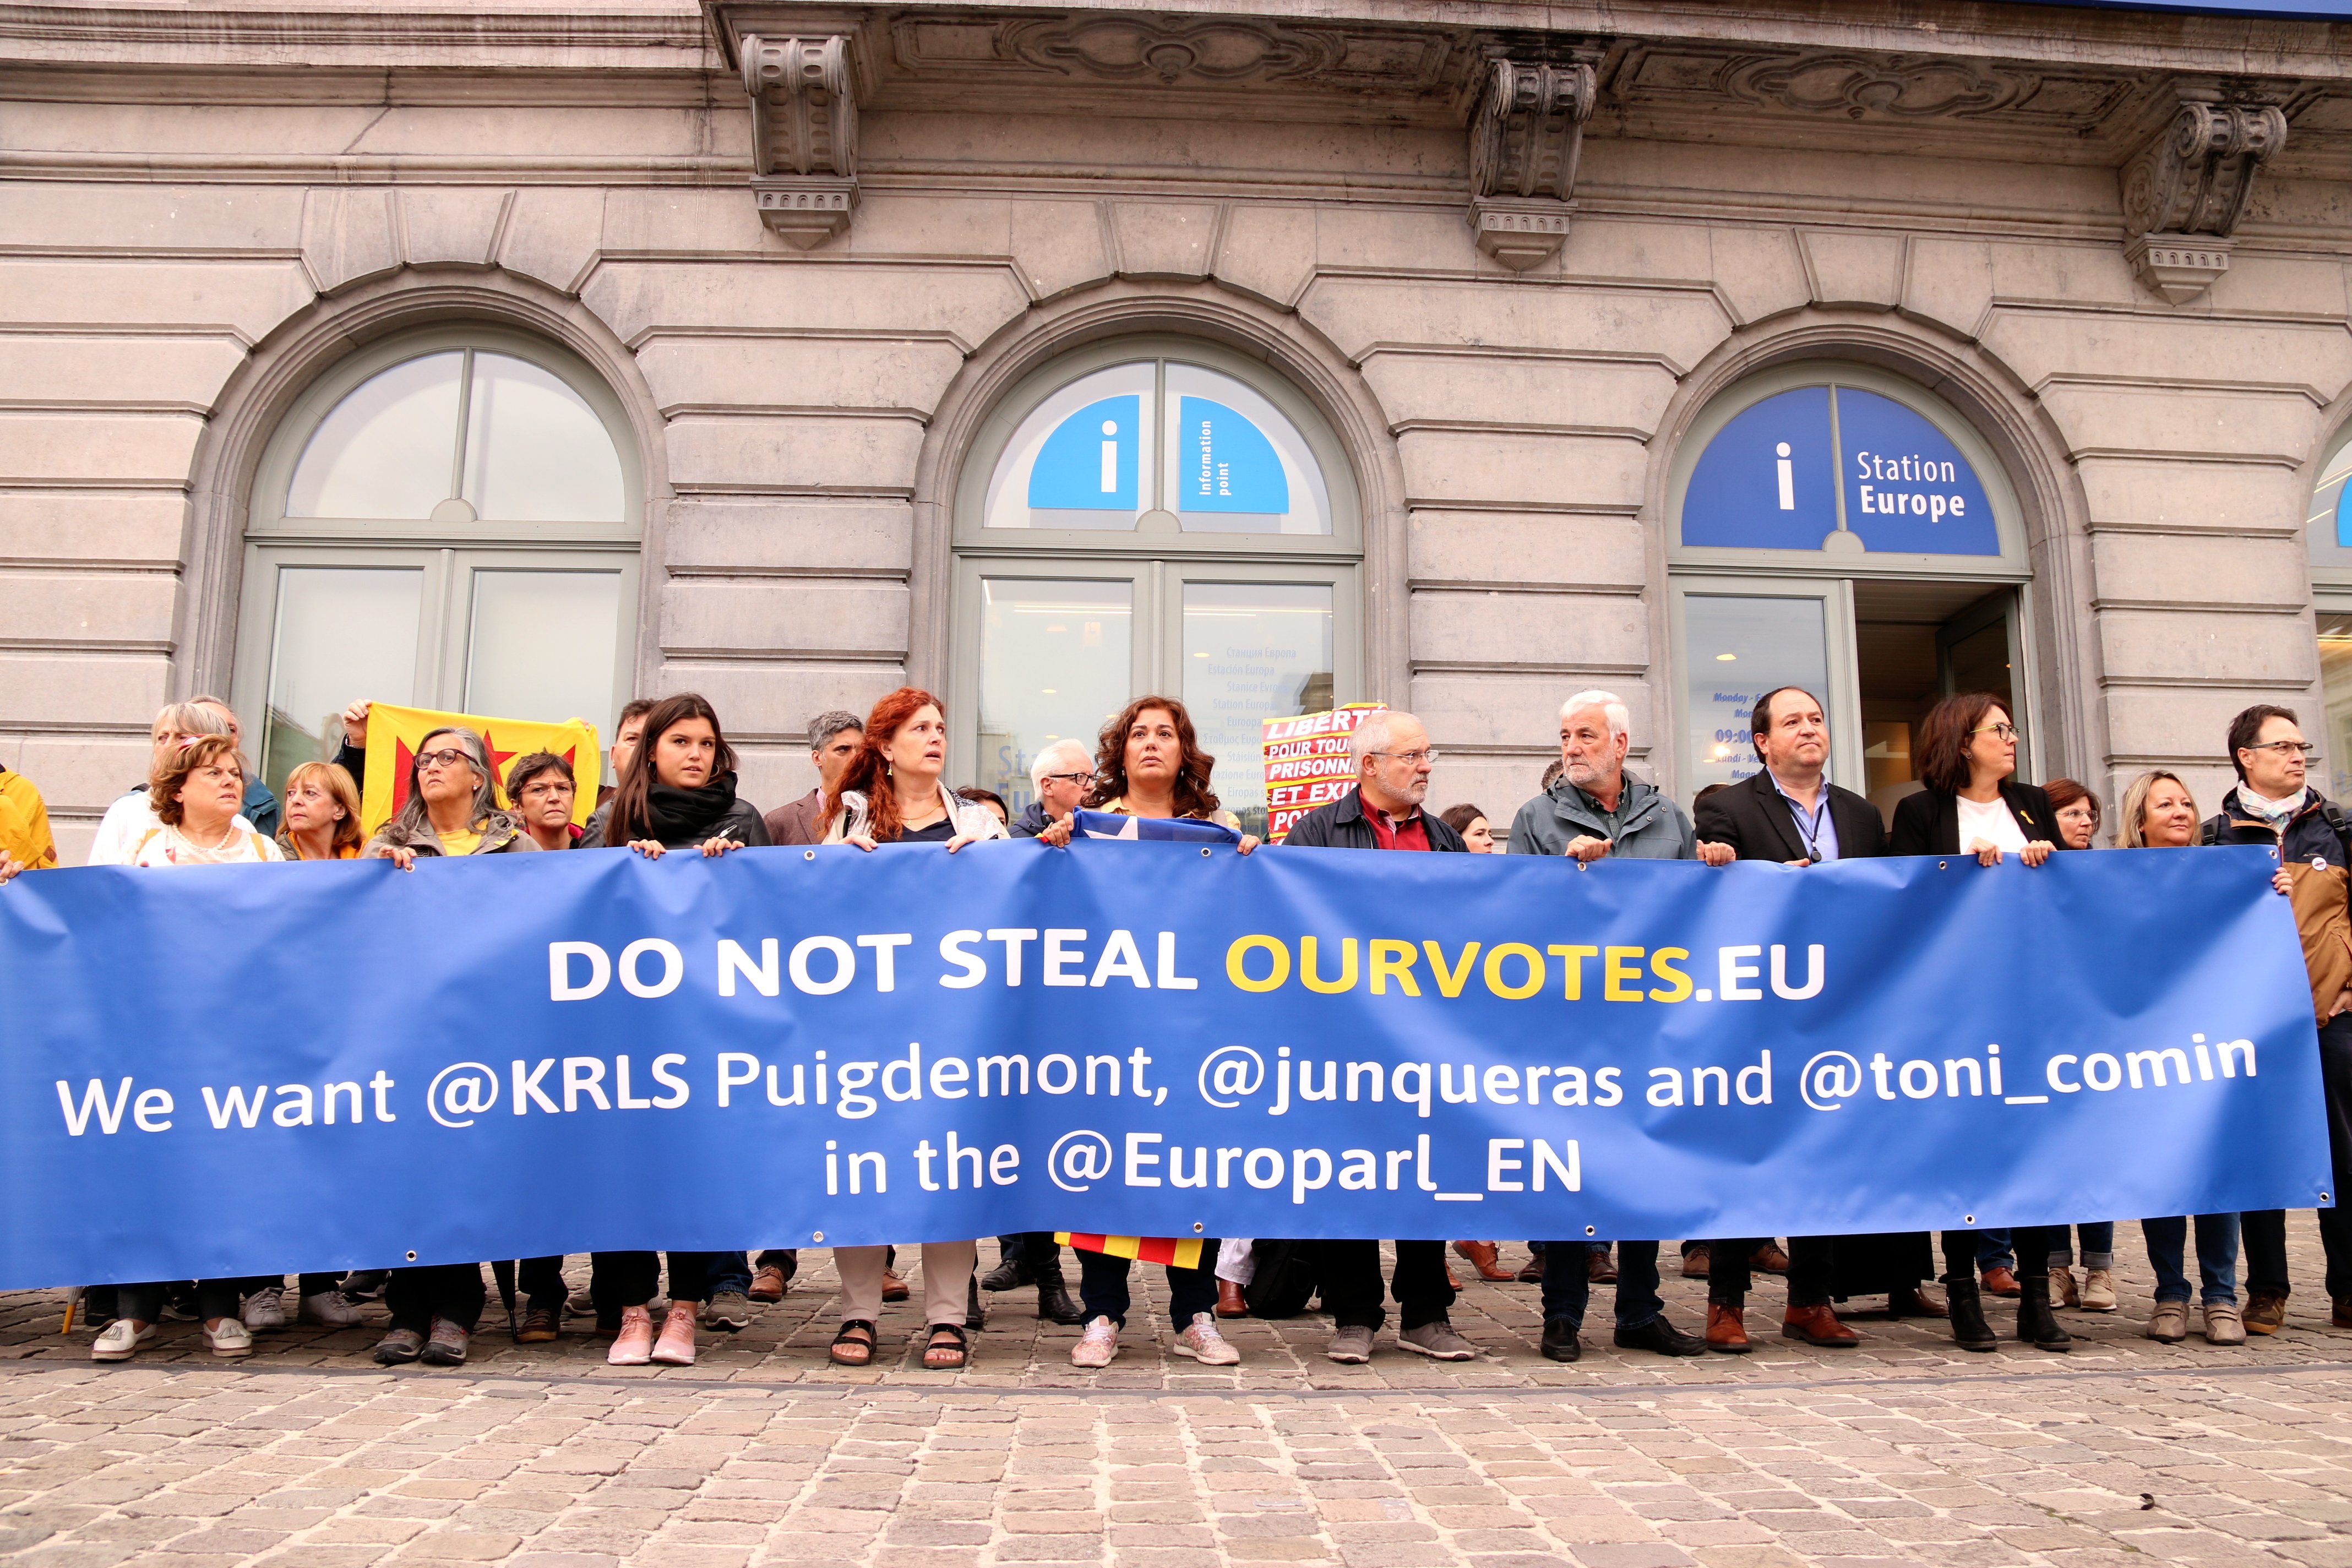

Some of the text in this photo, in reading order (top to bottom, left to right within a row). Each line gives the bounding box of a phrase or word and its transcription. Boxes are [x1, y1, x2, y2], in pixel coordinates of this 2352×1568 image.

[1198, 421, 1211, 496] Information
[1858, 451, 1955, 482] Station
[1216, 462, 1232, 496] point
[1860, 485, 1964, 523] Europe
[1227, 646, 1296, 660] Станция Европа
[1208, 664, 1275, 677] Estación Europa
[1227, 681, 1258, 692] Stanice
[1213, 698, 1243, 709] Station
[1713, 693, 1748, 704] Monday
[1268, 738, 1351, 760] POUR TOU
[1228, 786, 1260, 799] Eiropas
[1271, 786, 1303, 805] ET
[548, 928, 1825, 1004] DO NOT STEAL OURVOTES.EU
[55, 1032, 2257, 1137] We want @KRLS Puigdemont, @junqueras and @toni_comin
[825, 1129, 1581, 1205] in the @Europarl_EN
